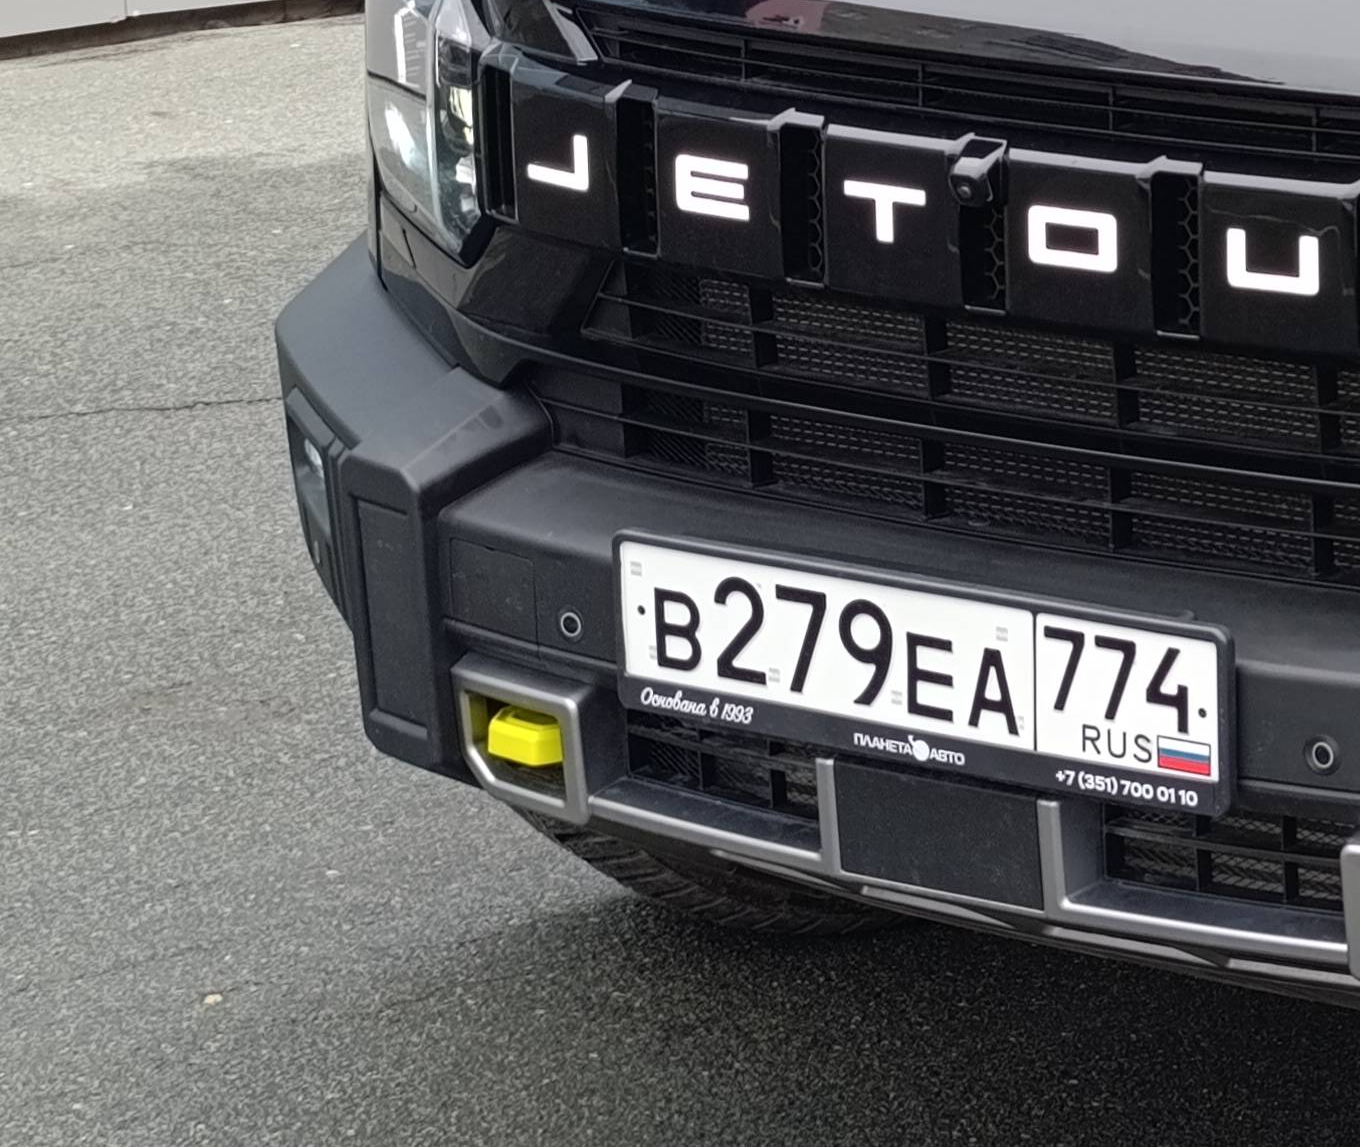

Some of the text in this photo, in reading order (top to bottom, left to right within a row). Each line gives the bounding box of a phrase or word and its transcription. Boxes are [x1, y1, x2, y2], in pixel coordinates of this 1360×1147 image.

[1043, 625, 1190, 735] 774
[640, 687, 754, 724] Основана в 1993
[853, 732, 966, 765] ПЛАНЕТА АВТО
[1082, 724, 1152, 763] RUS
[1055, 770, 1198, 806] +7 (351) 700 01 10
